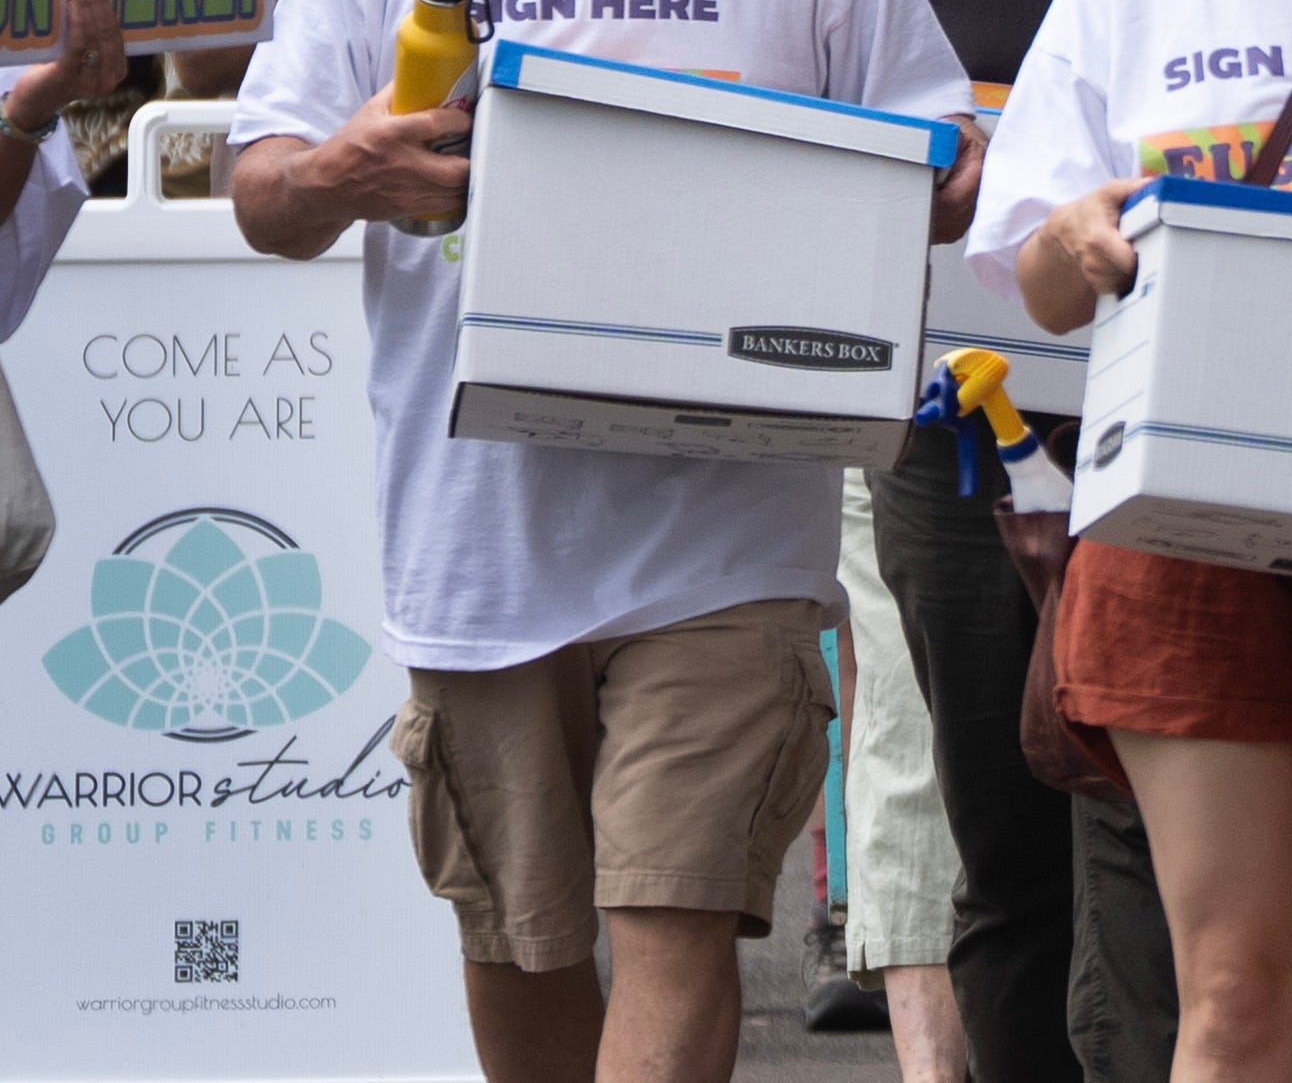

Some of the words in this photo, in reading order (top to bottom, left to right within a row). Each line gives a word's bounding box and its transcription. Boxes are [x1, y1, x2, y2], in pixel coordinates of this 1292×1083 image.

[1164, 44, 1285, 93] SIGN
[83, 333, 241, 379] COME
[263, 332, 333, 377] AS
[742, 335, 834, 358] BANKERS
[837, 344, 881, 363] BOX
[100, 398, 205, 442] YOU
[229, 396, 315, 440] ARE
[0, 771, 203, 809] WARRIOR
[210, 714, 413, 808] studio
[41, 822, 169, 845] GROUP
[205, 819, 373, 842] FITNESS
[76, 993, 337, 1015] warriorgroupfitnessstudio.com
